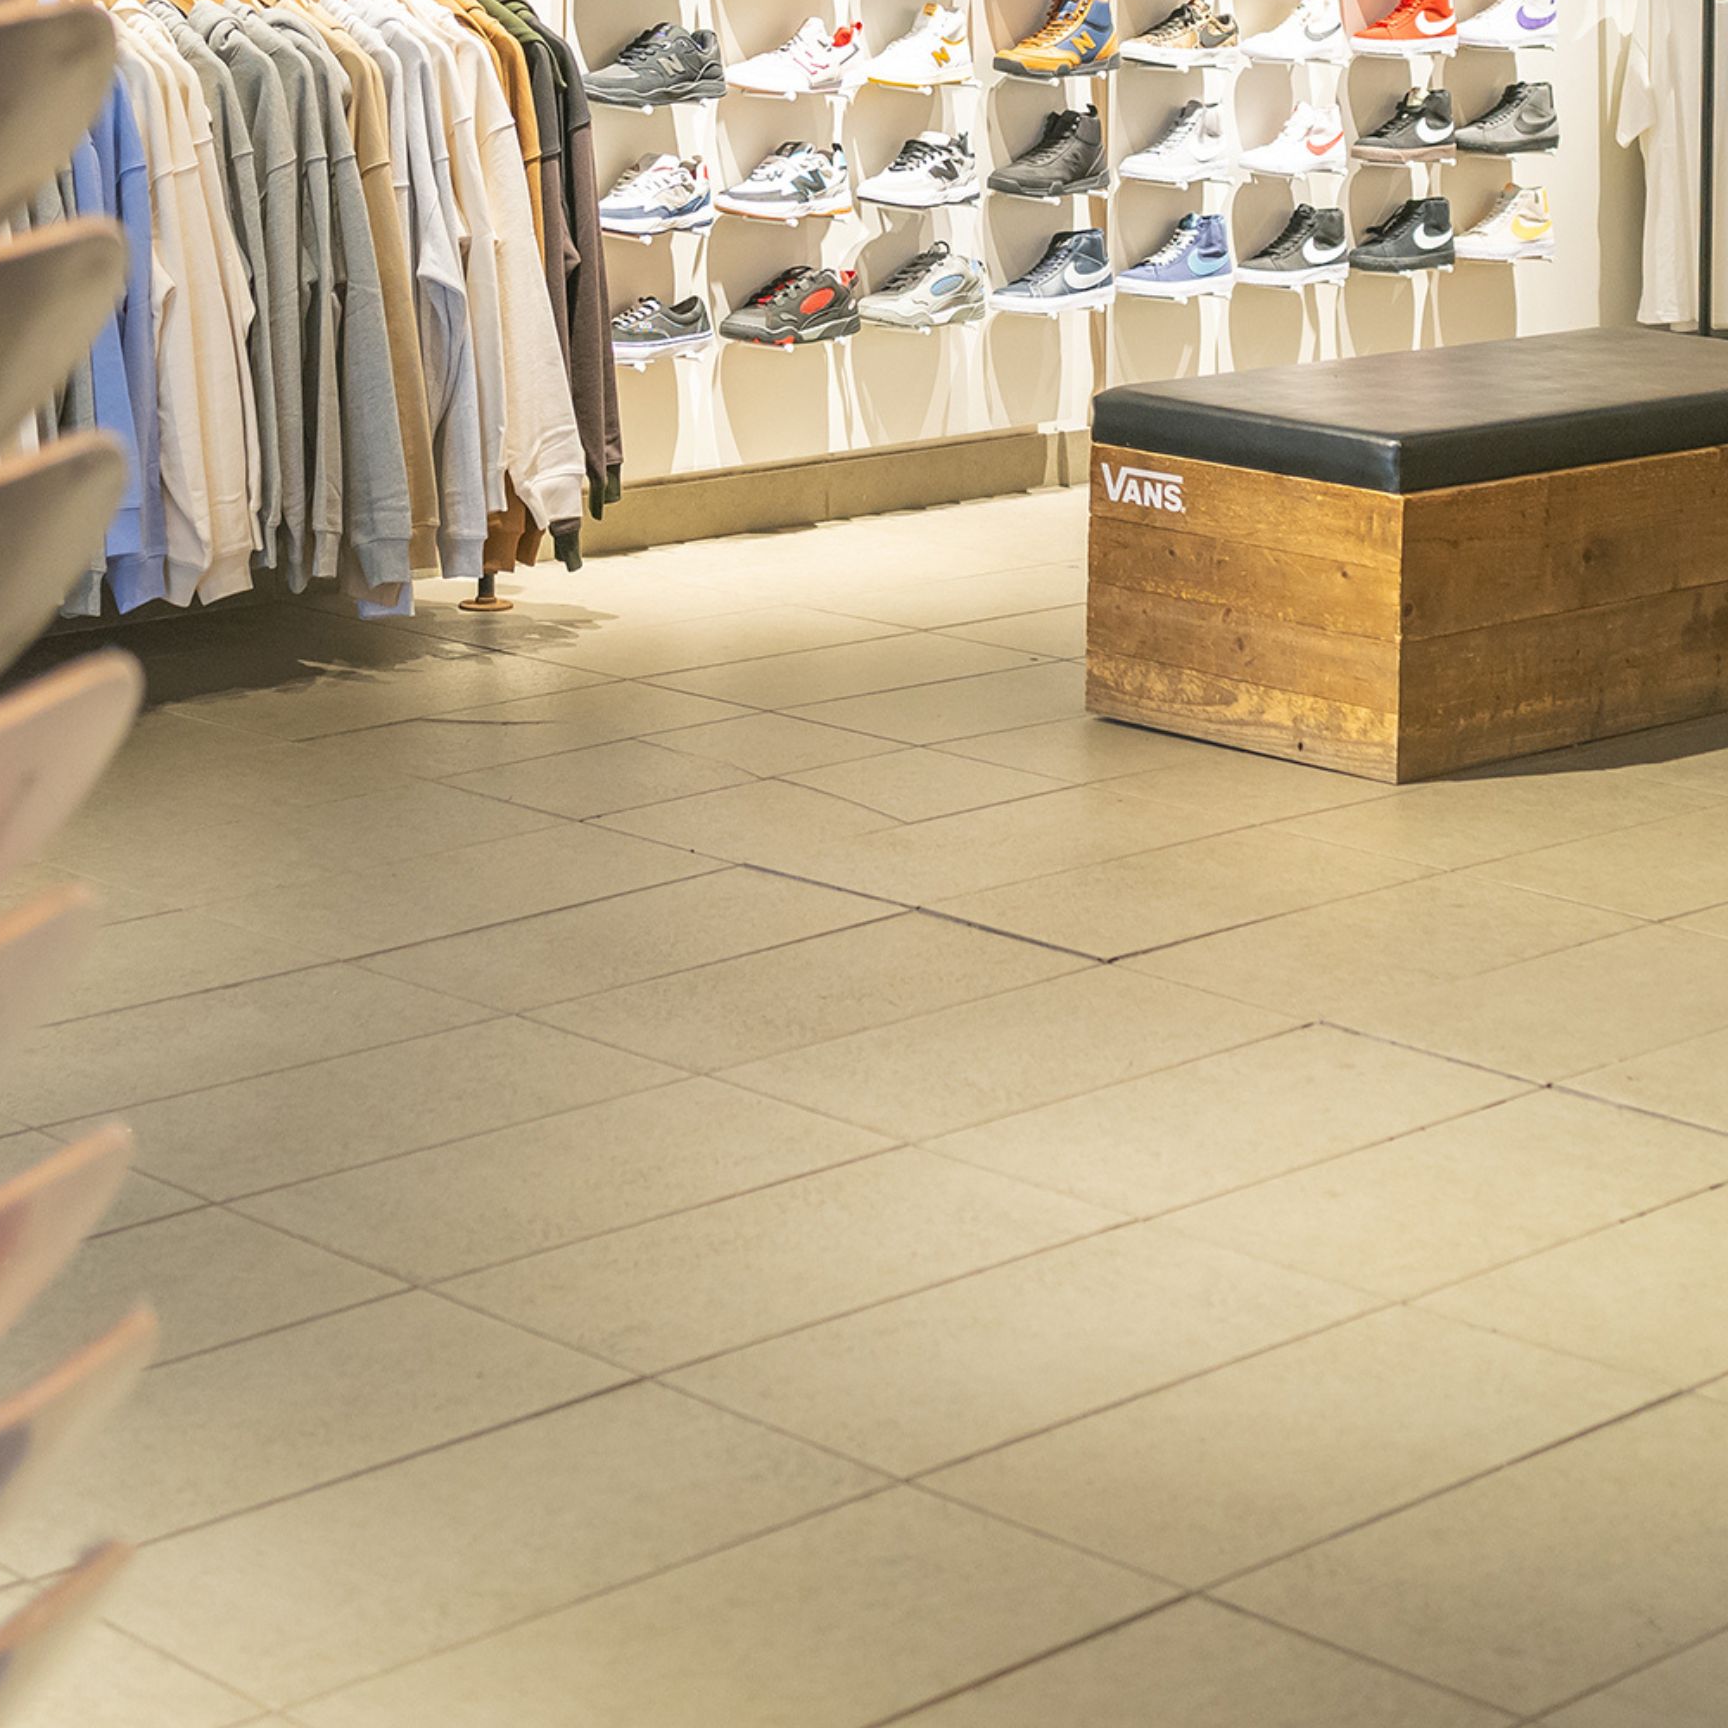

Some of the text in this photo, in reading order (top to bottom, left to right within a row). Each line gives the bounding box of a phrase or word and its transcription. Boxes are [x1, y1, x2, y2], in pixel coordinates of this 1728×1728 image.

[1071, 30, 1097, 56] N
[656, 55, 686, 77] N
[1101, 462, 1186, 514] VANS
